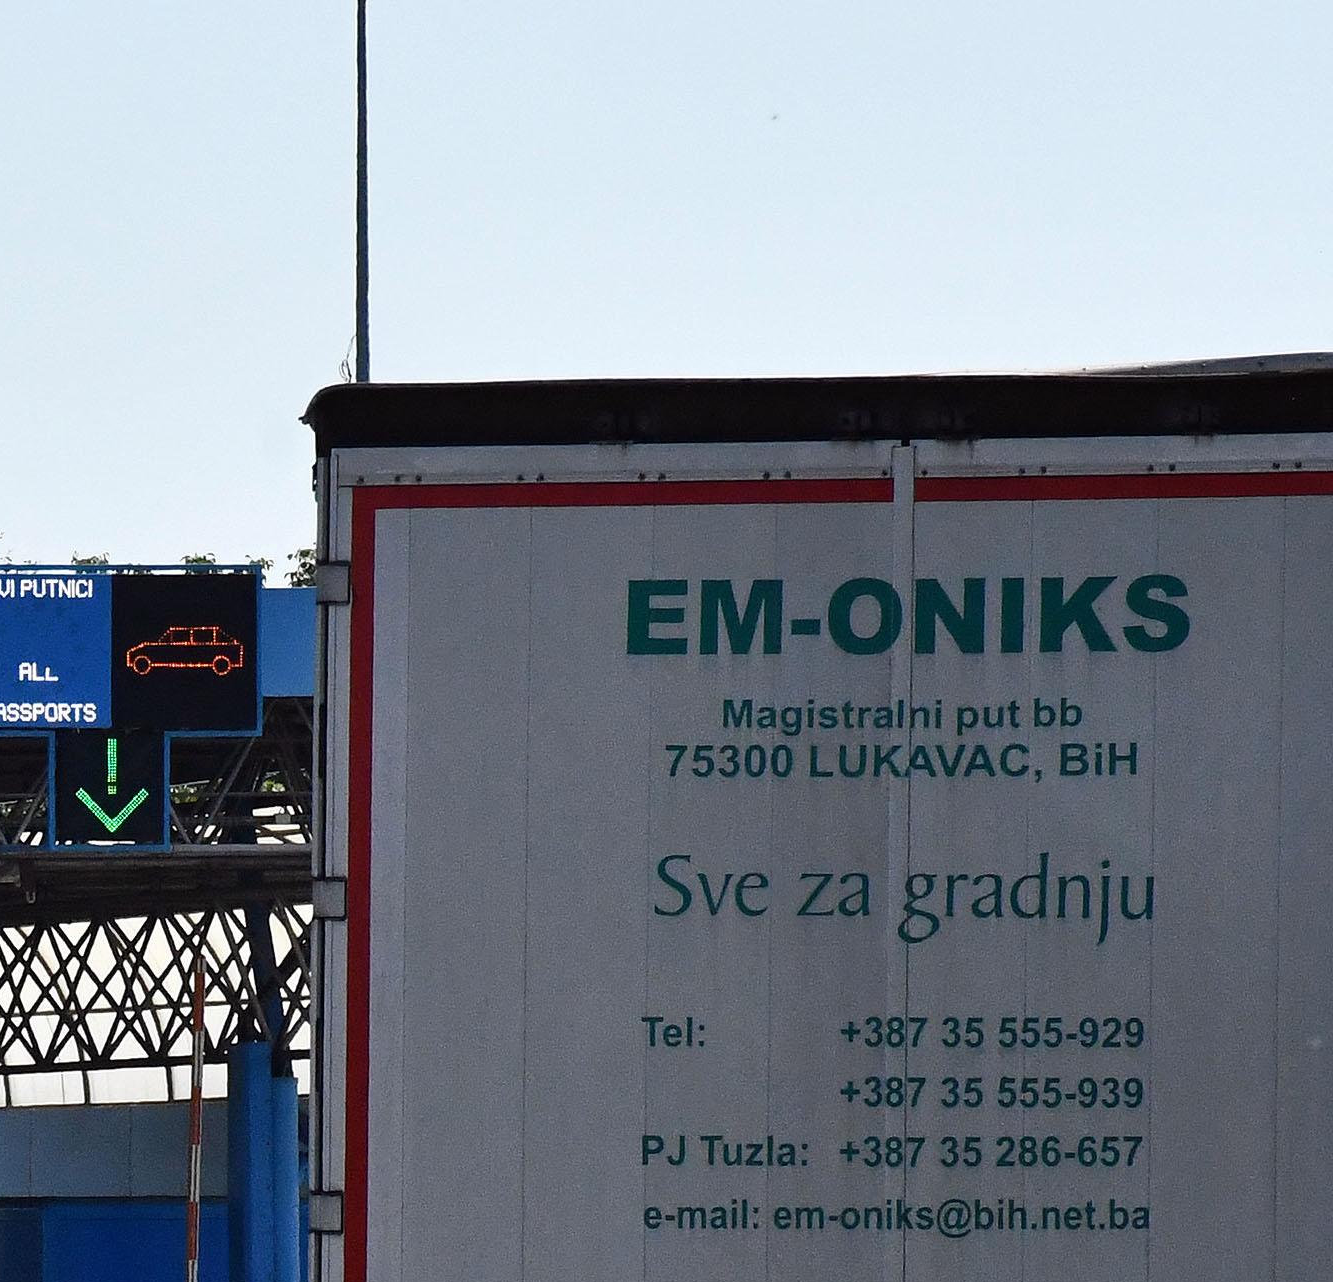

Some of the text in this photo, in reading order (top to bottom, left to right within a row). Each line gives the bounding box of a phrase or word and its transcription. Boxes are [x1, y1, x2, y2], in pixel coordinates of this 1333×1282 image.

[20, 578, 93, 598] PUTNICI
[628, 574, 1191, 656] EM-ONIKS
[18, 661, 59, 681] ALL
[723, 697, 1083, 737] Magistralni put bb
[665, 742, 1139, 783] 75300 LUKAVAC, BiH
[654, 852, 1156, 945] Sve za gradnju
[641, 1017, 1145, 1049] Tel: +387 35 555-929
[840, 1076, 1144, 1109] +387 35 555-939
[642, 1135, 1143, 1168] PJ Tuzla: +387 35 286-657
[643, 1198, 1150, 1239] e-mail: em-oniks@bih.net.ba
